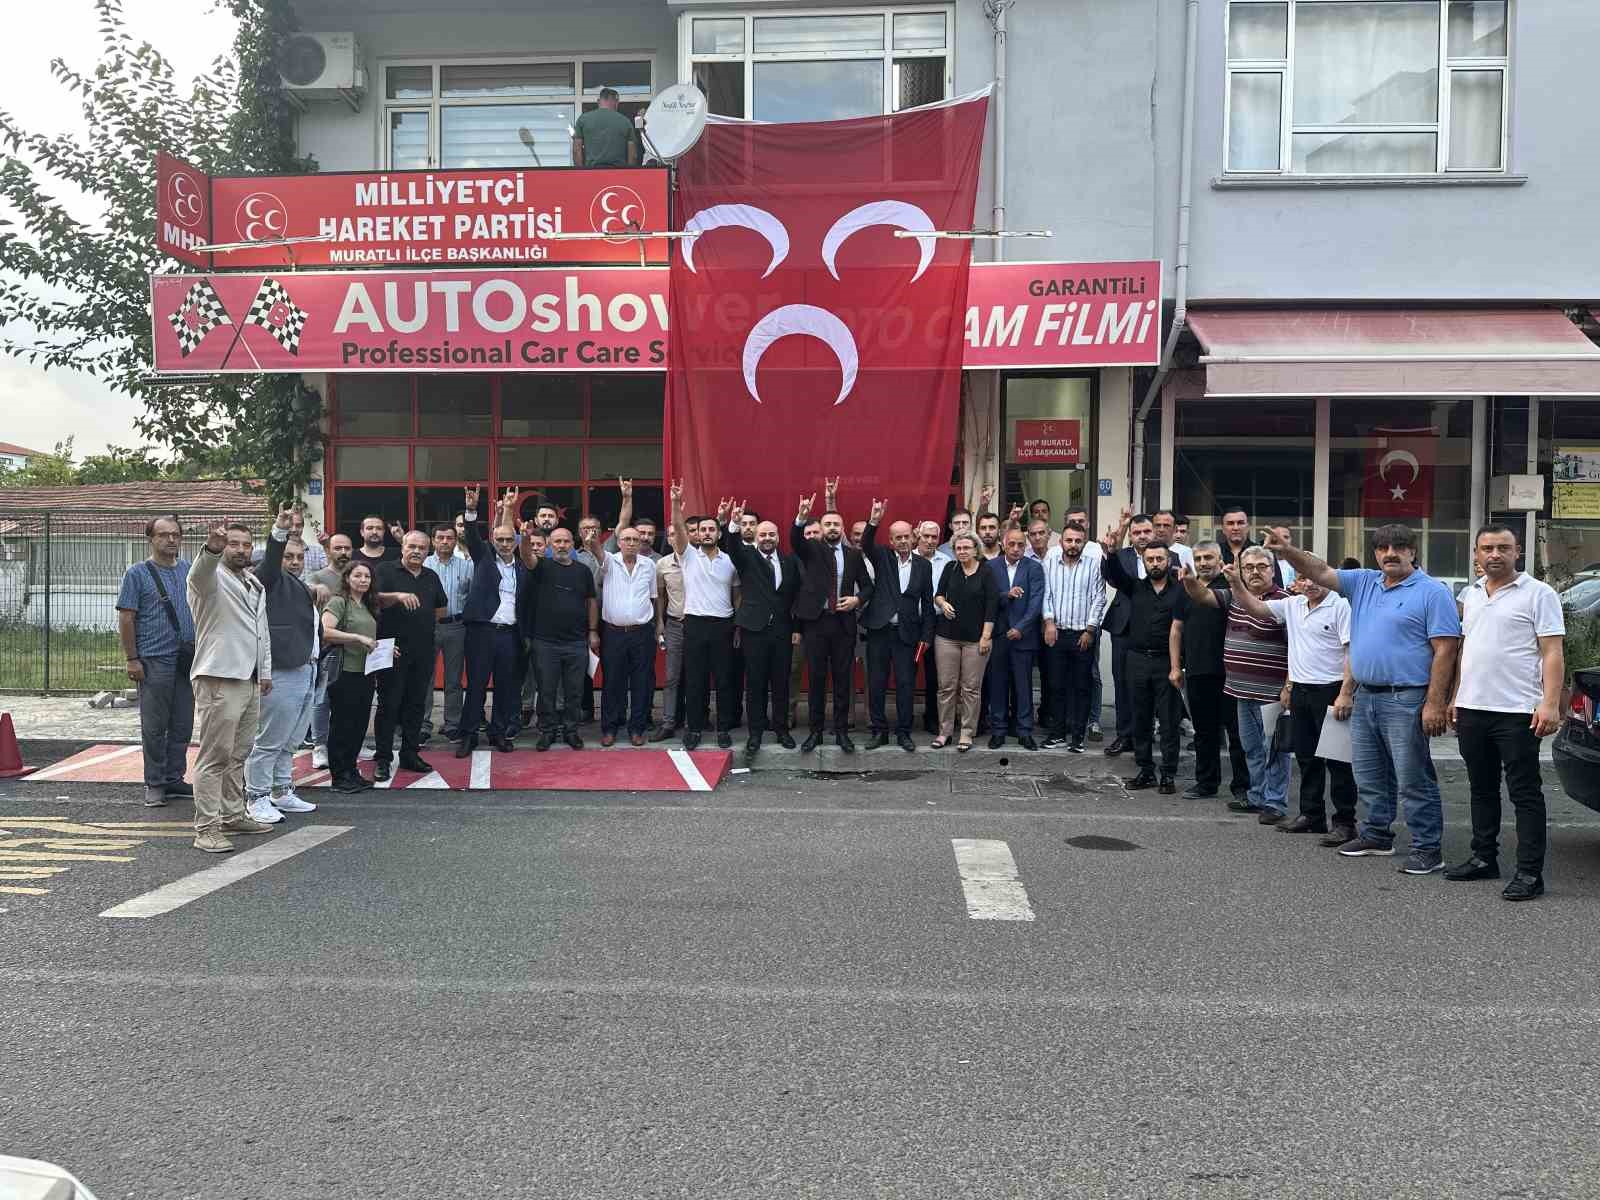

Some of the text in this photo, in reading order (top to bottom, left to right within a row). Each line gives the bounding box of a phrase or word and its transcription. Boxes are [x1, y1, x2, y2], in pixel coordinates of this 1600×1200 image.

[355, 173, 525, 206] MİLLİYETÇİ
[163, 222, 208, 255] MHP
[319, 207, 562, 242] HAREKET PARTİSİ
[330, 244, 548, 263] MURATLI İLÇE BAŞKANLIĞI
[342, 340, 512, 364] Professional
[521, 341, 569, 364] Car
[576, 341, 641, 364] Care
[1099, 480, 1111, 490] 60
